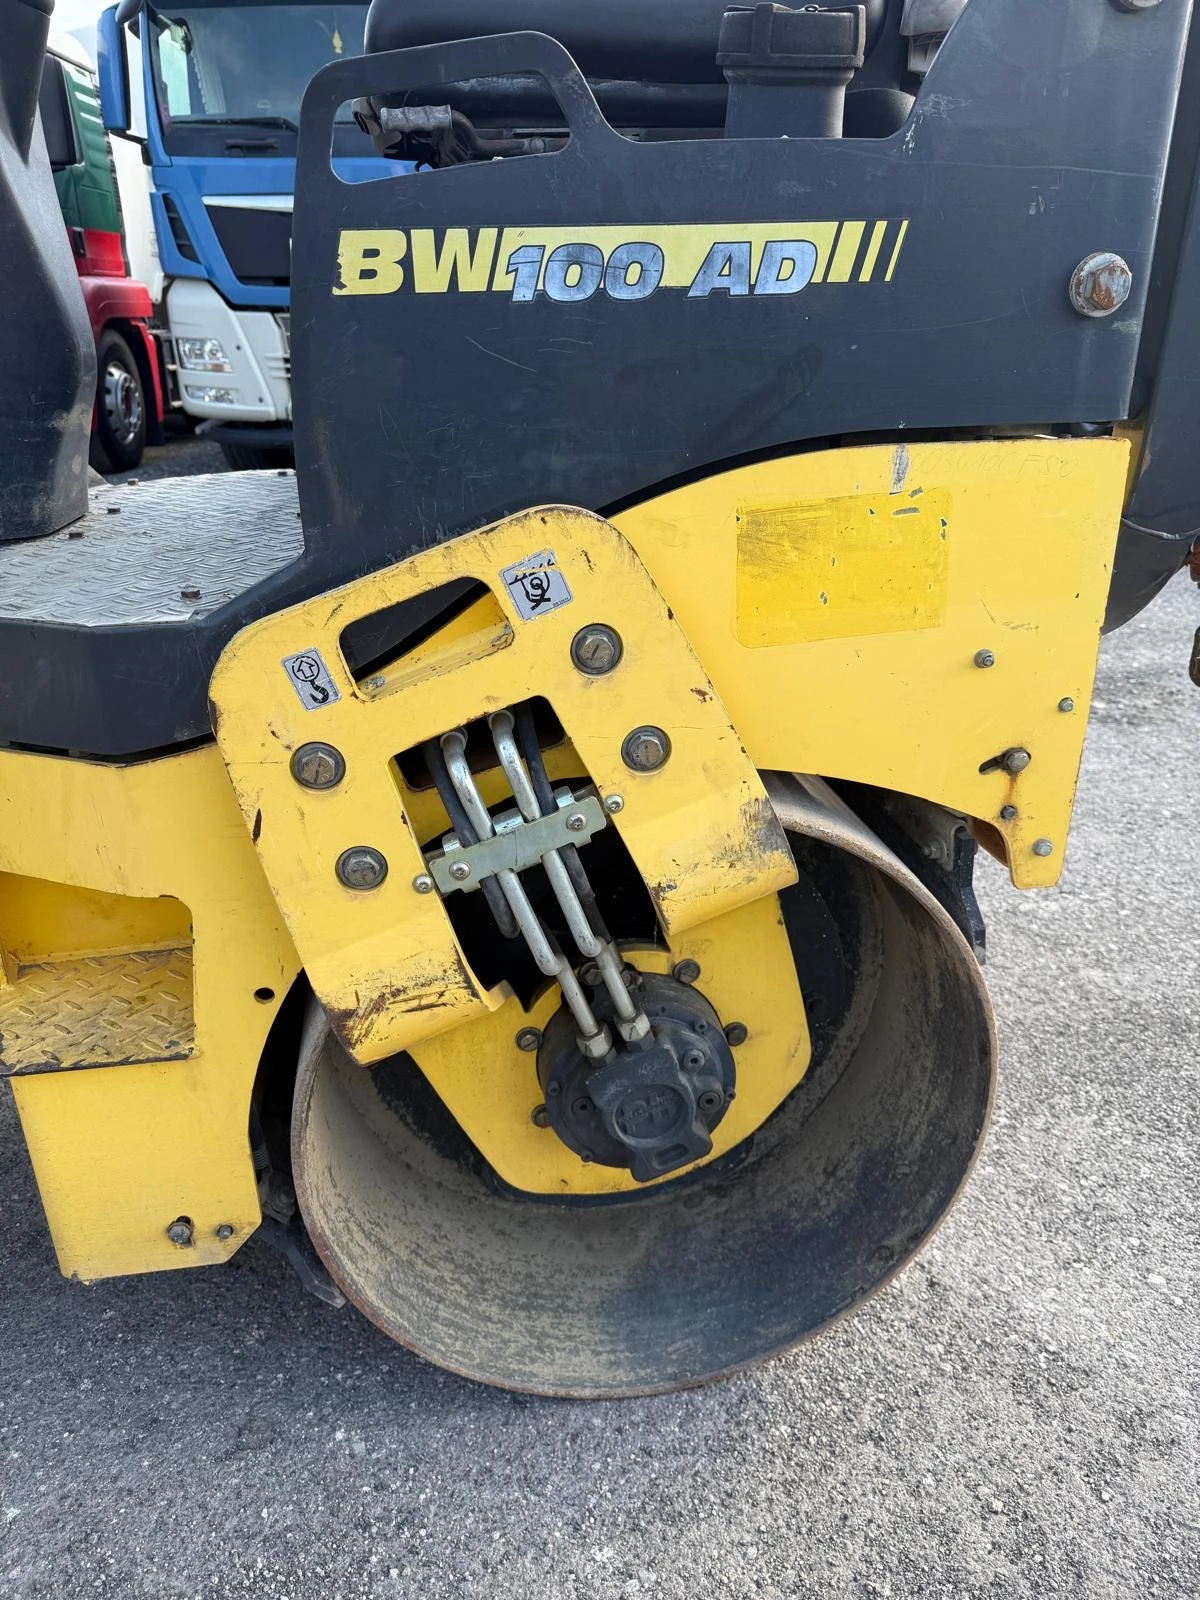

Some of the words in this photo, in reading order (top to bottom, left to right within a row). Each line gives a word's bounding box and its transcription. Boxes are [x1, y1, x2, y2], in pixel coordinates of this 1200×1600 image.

[332, 228, 498, 295] BW
[506, 242, 665, 303] 100
[685, 239, 818, 299] AD
